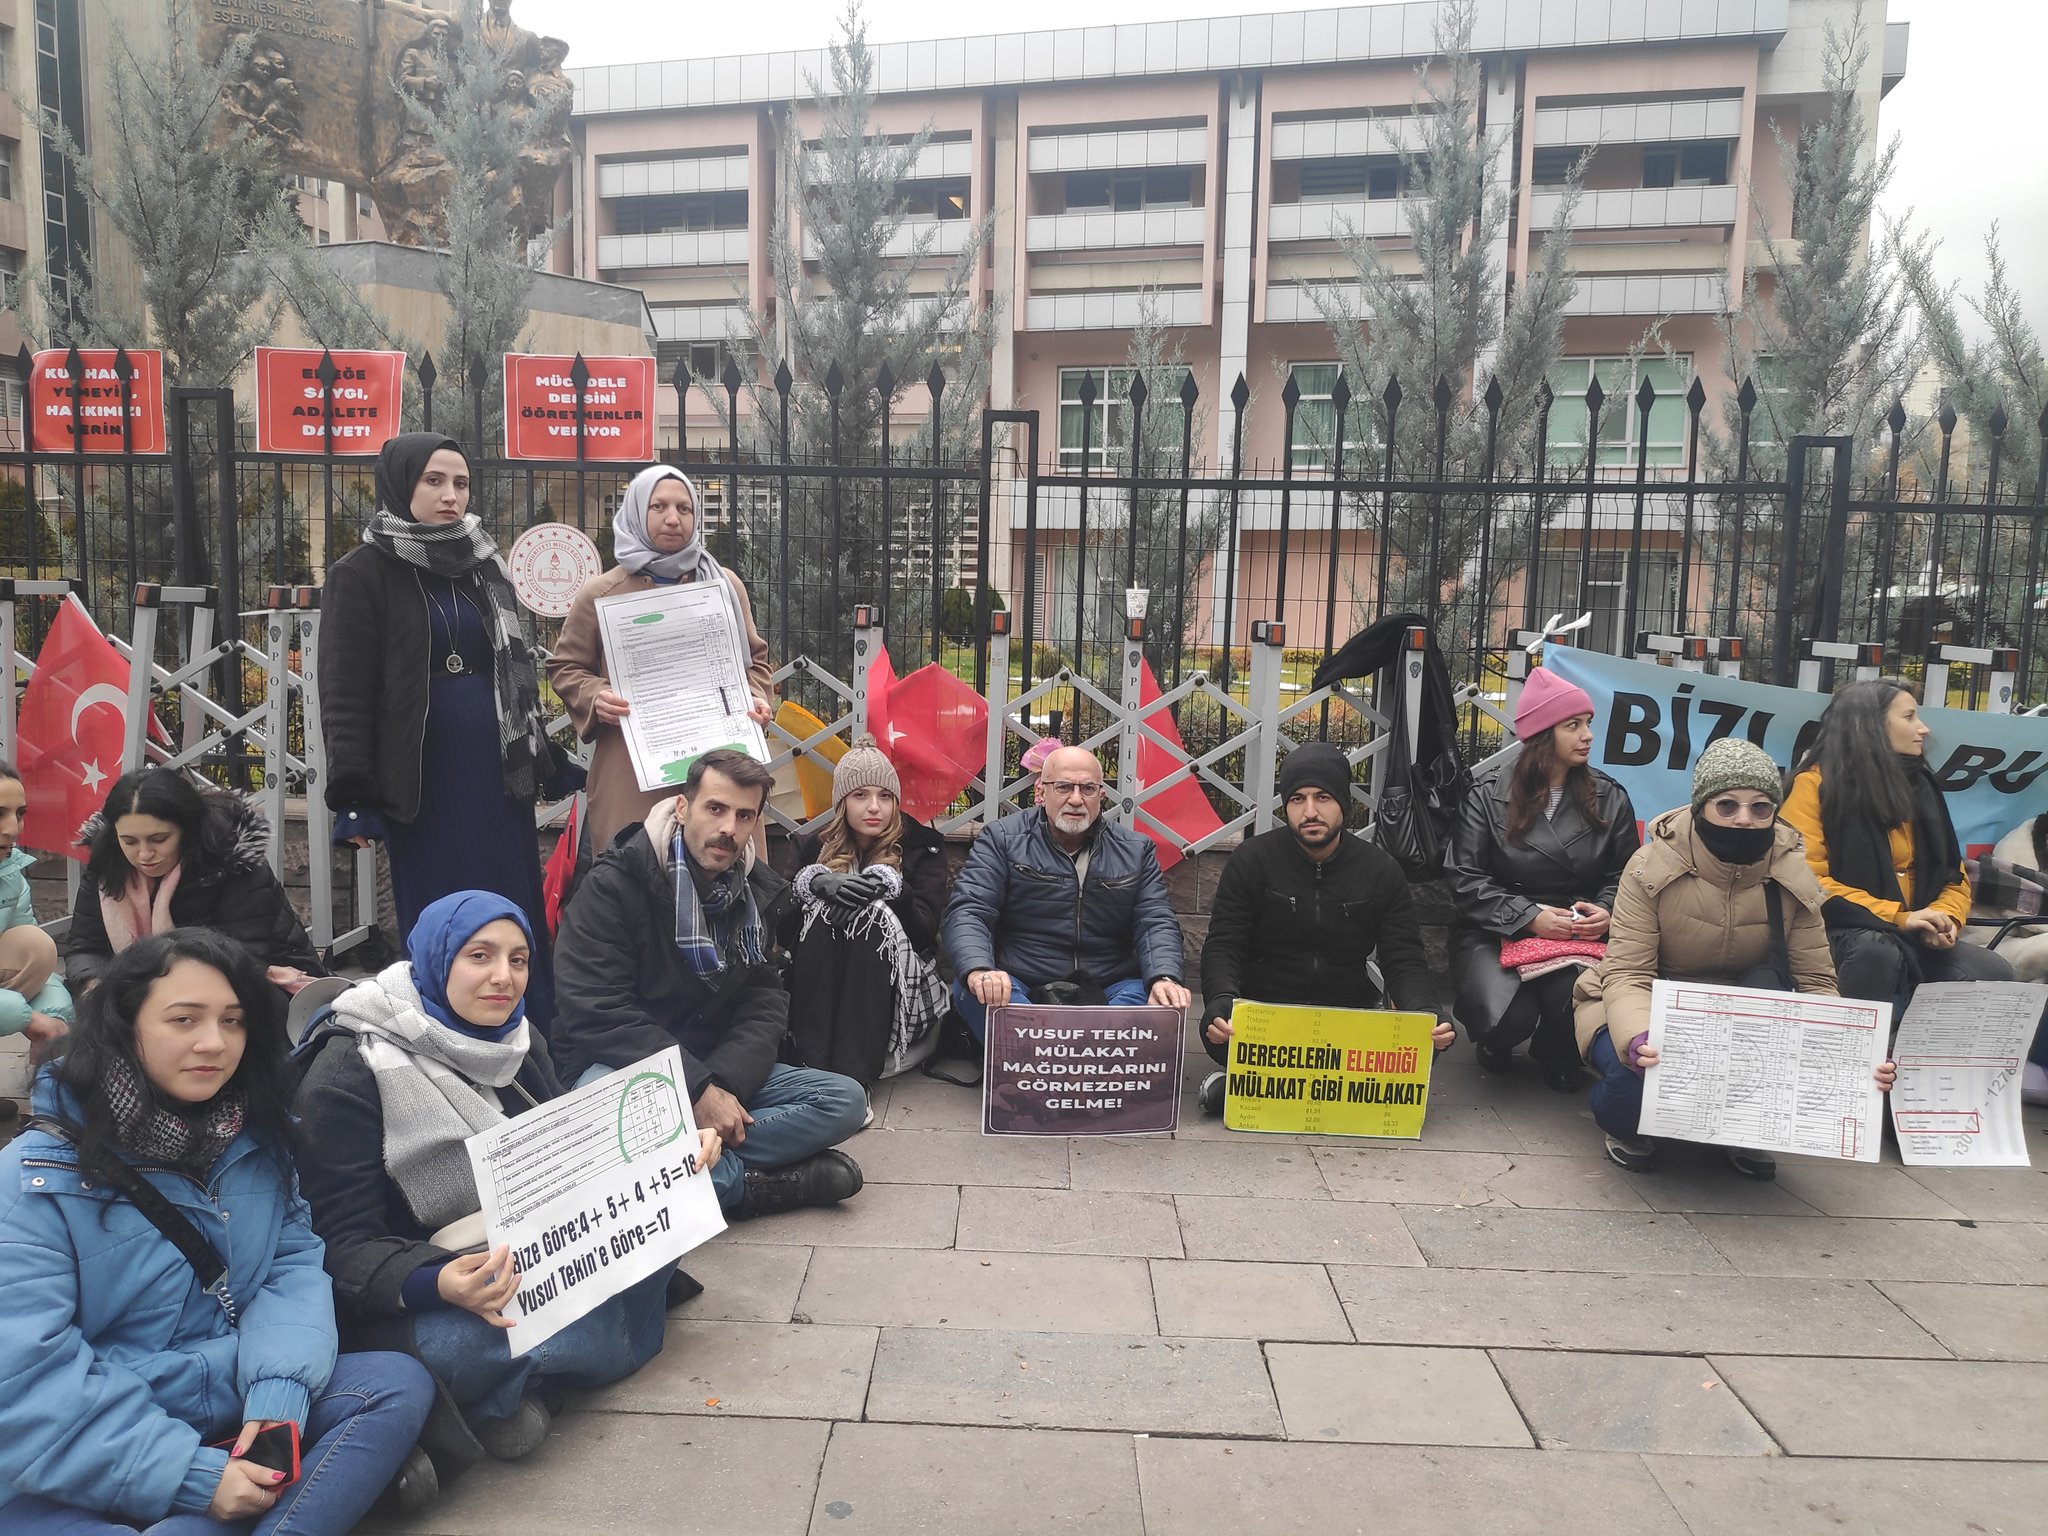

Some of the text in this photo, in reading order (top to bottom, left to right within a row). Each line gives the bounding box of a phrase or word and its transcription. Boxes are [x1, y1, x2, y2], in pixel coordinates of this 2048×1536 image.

[535, 374, 627, 388] MÜCDELE
[1014, 1026, 1159, 1042] YUSUF TEKİN,
[1034, 1044, 1139, 1058] MÜLAKAT
[1236, 1042, 1418, 1074] DERECELERİN ELENDİĞİ
[1002, 1061, 1167, 1075] MAĞDURLARINI
[1016, 1078, 1151, 1092] GÖRMEZDEN
[1228, 1070, 1425, 1106] MÜLAKAT GİBİ MÜLAKAT
[1045, 1098, 1123, 1109] GELME!
[513, 1241, 541, 1275] Bize
[516, 1272, 559, 1317] Yusuf
